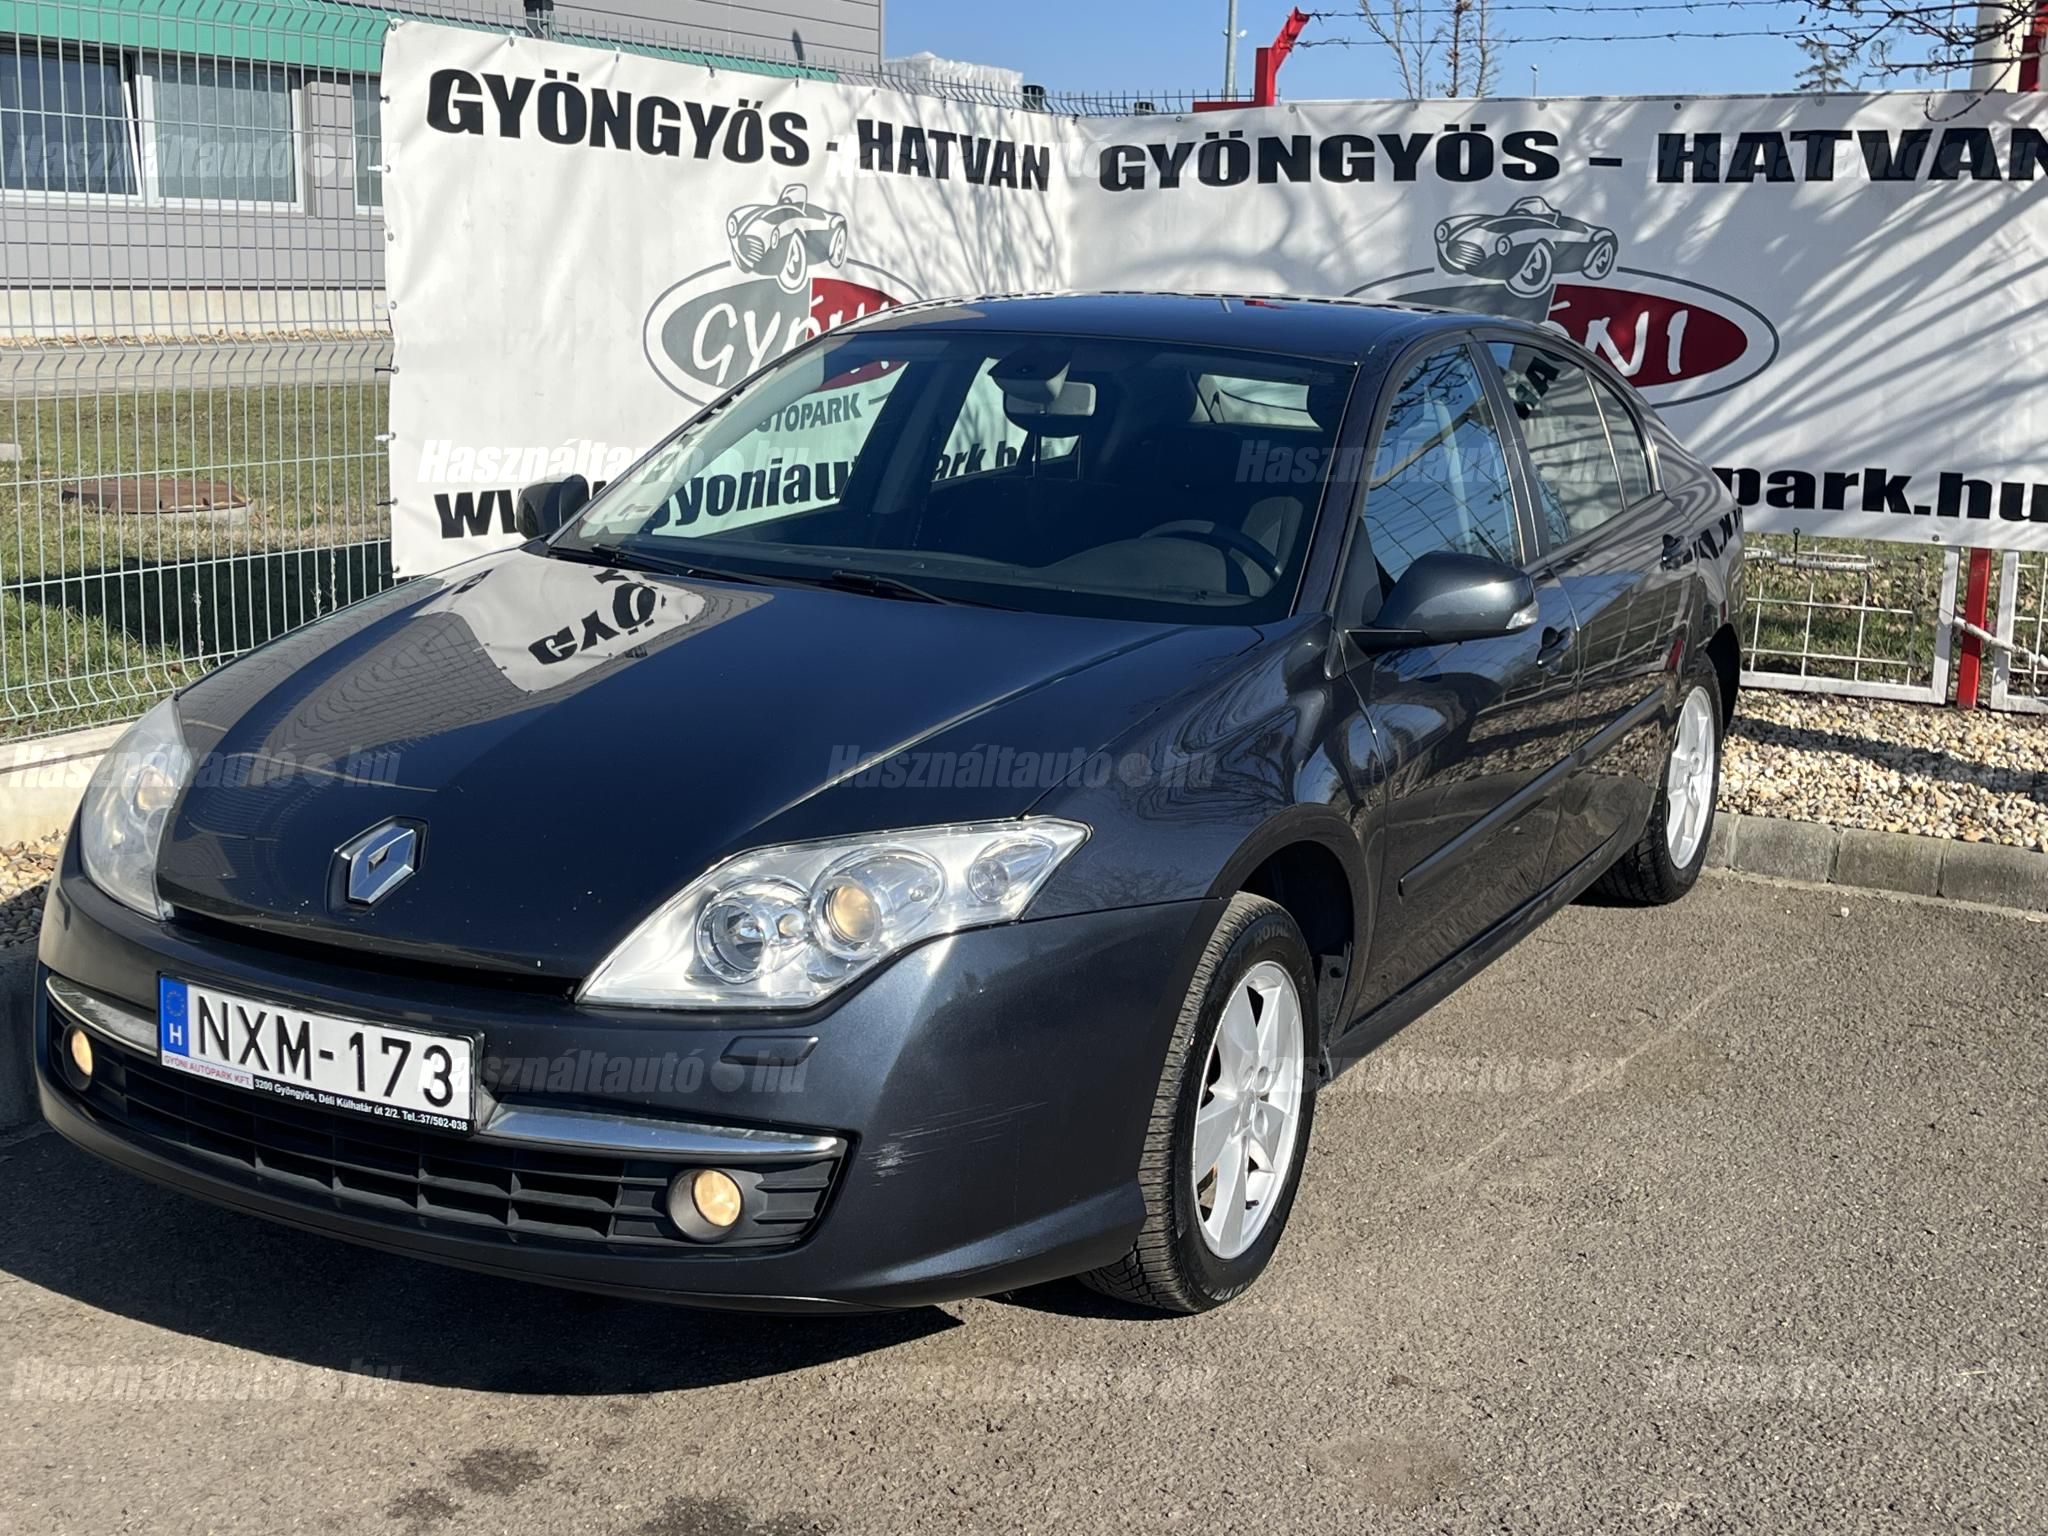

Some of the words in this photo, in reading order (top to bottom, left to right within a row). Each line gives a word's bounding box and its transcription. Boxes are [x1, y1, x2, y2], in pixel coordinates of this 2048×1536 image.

[427, 68, 810, 167] GYÖNGYÖS
[856, 118, 1050, 192] HATVAN
[1099, 123, 1561, 192] GYÖNGYÖS
[1656, 127, 2048, 183] HATVAN
[168, 1022, 183, 1047] H
[199, 996, 454, 1108] NXM-173
[318, 1093, 335, 1107] Déli
[336, 1097, 373, 1114] Külhatár
